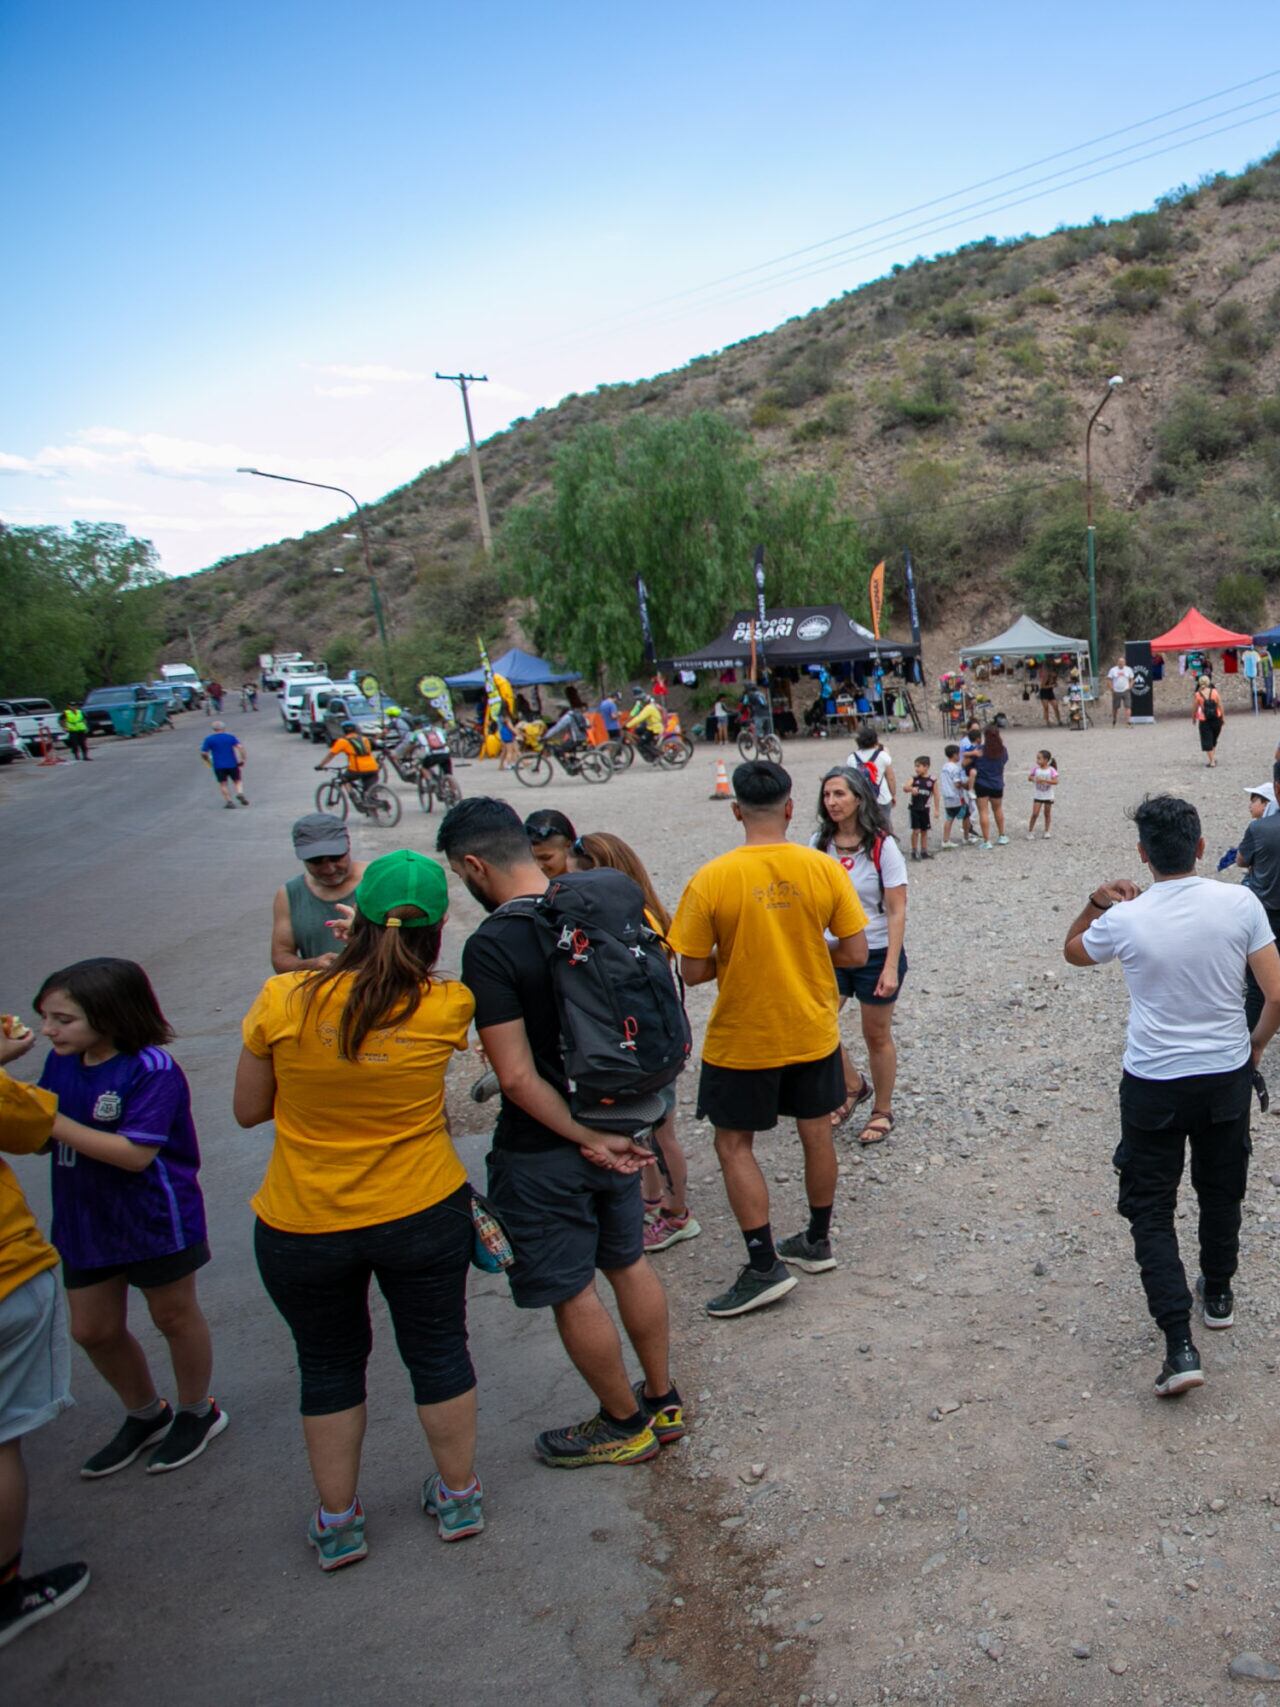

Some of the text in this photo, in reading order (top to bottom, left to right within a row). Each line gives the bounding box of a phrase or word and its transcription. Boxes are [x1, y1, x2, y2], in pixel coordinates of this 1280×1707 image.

[737, 617, 795, 630] OUTDOOR
[732, 624, 793, 641] PESARI
[57, 1141, 77, 1168] 10
